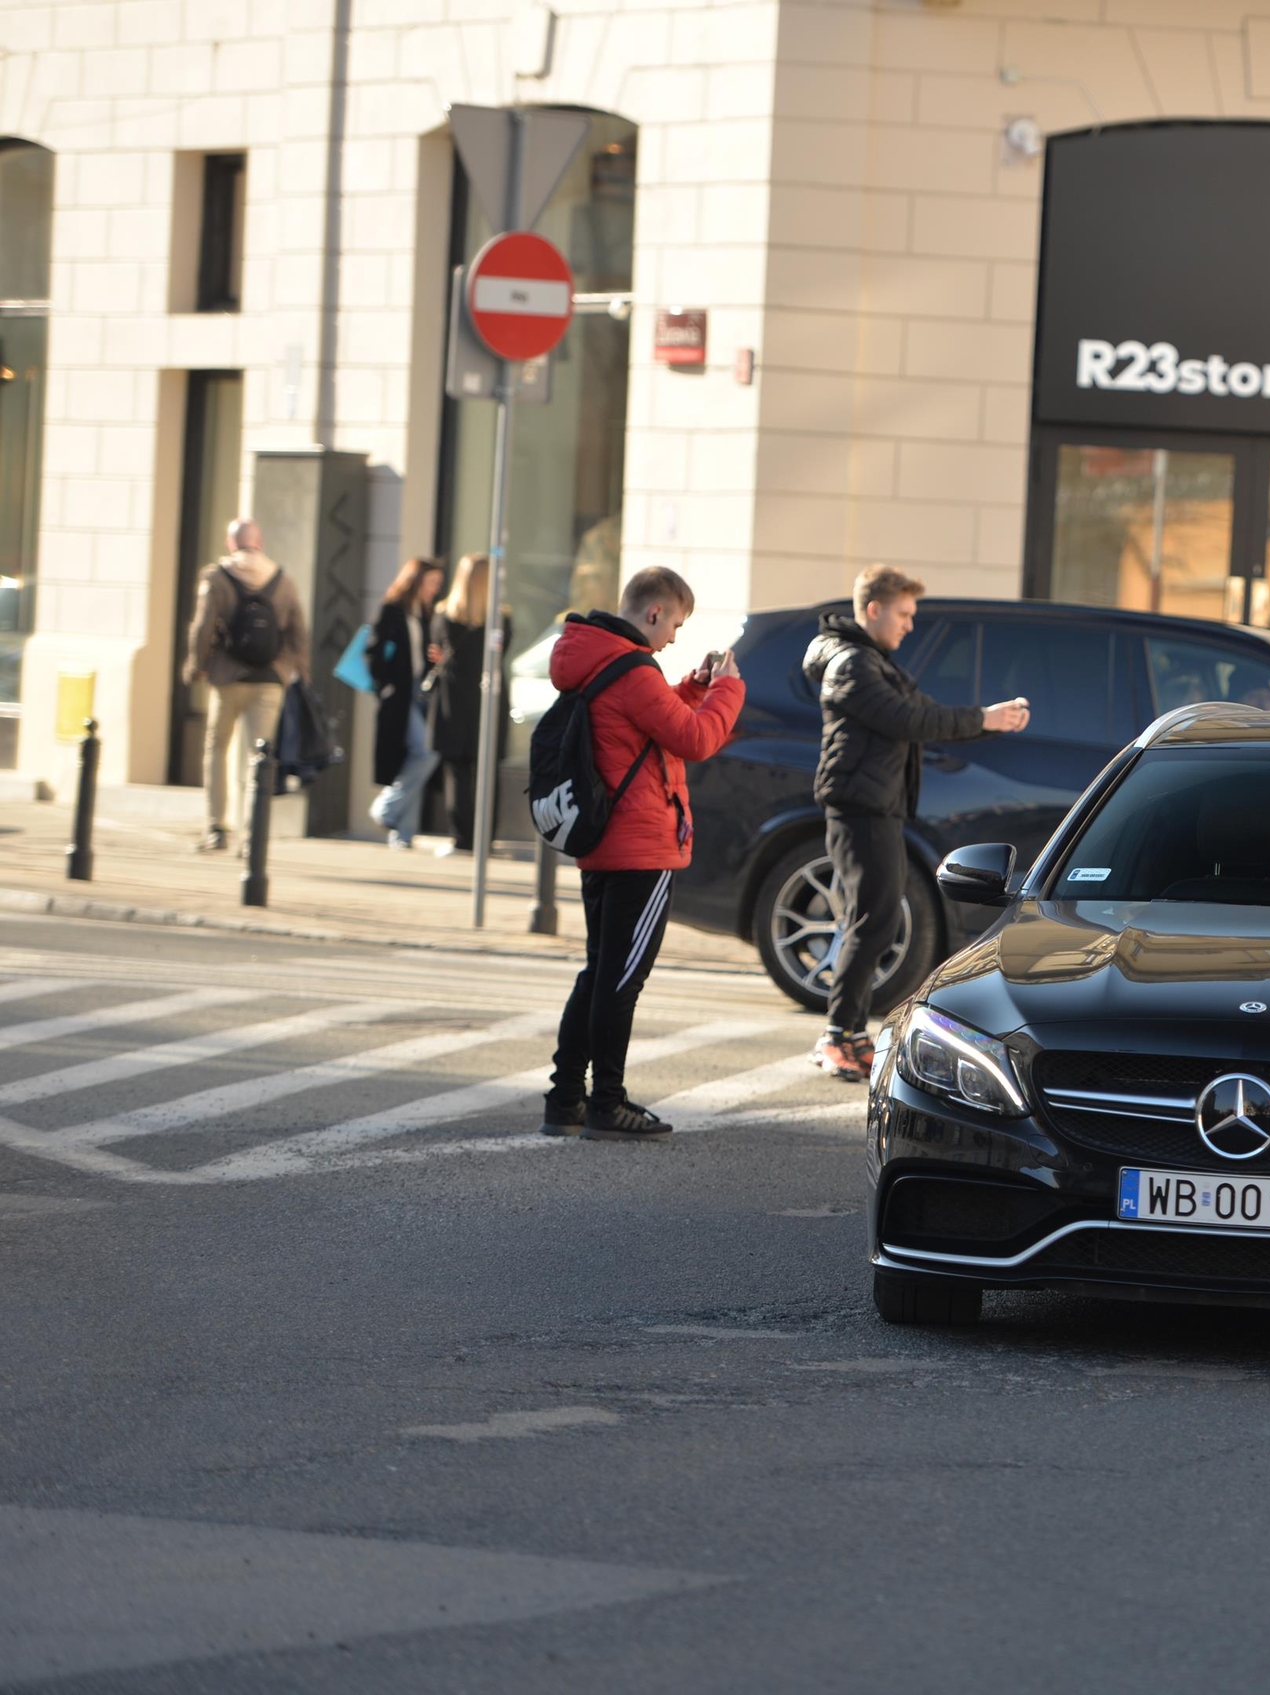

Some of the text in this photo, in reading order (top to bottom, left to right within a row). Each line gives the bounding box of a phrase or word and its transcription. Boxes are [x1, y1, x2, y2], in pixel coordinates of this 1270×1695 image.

[532, 779, 580, 834] NIKE
[1122, 1198, 1137, 1210] PL
[1149, 1176, 1197, 1217] WB
